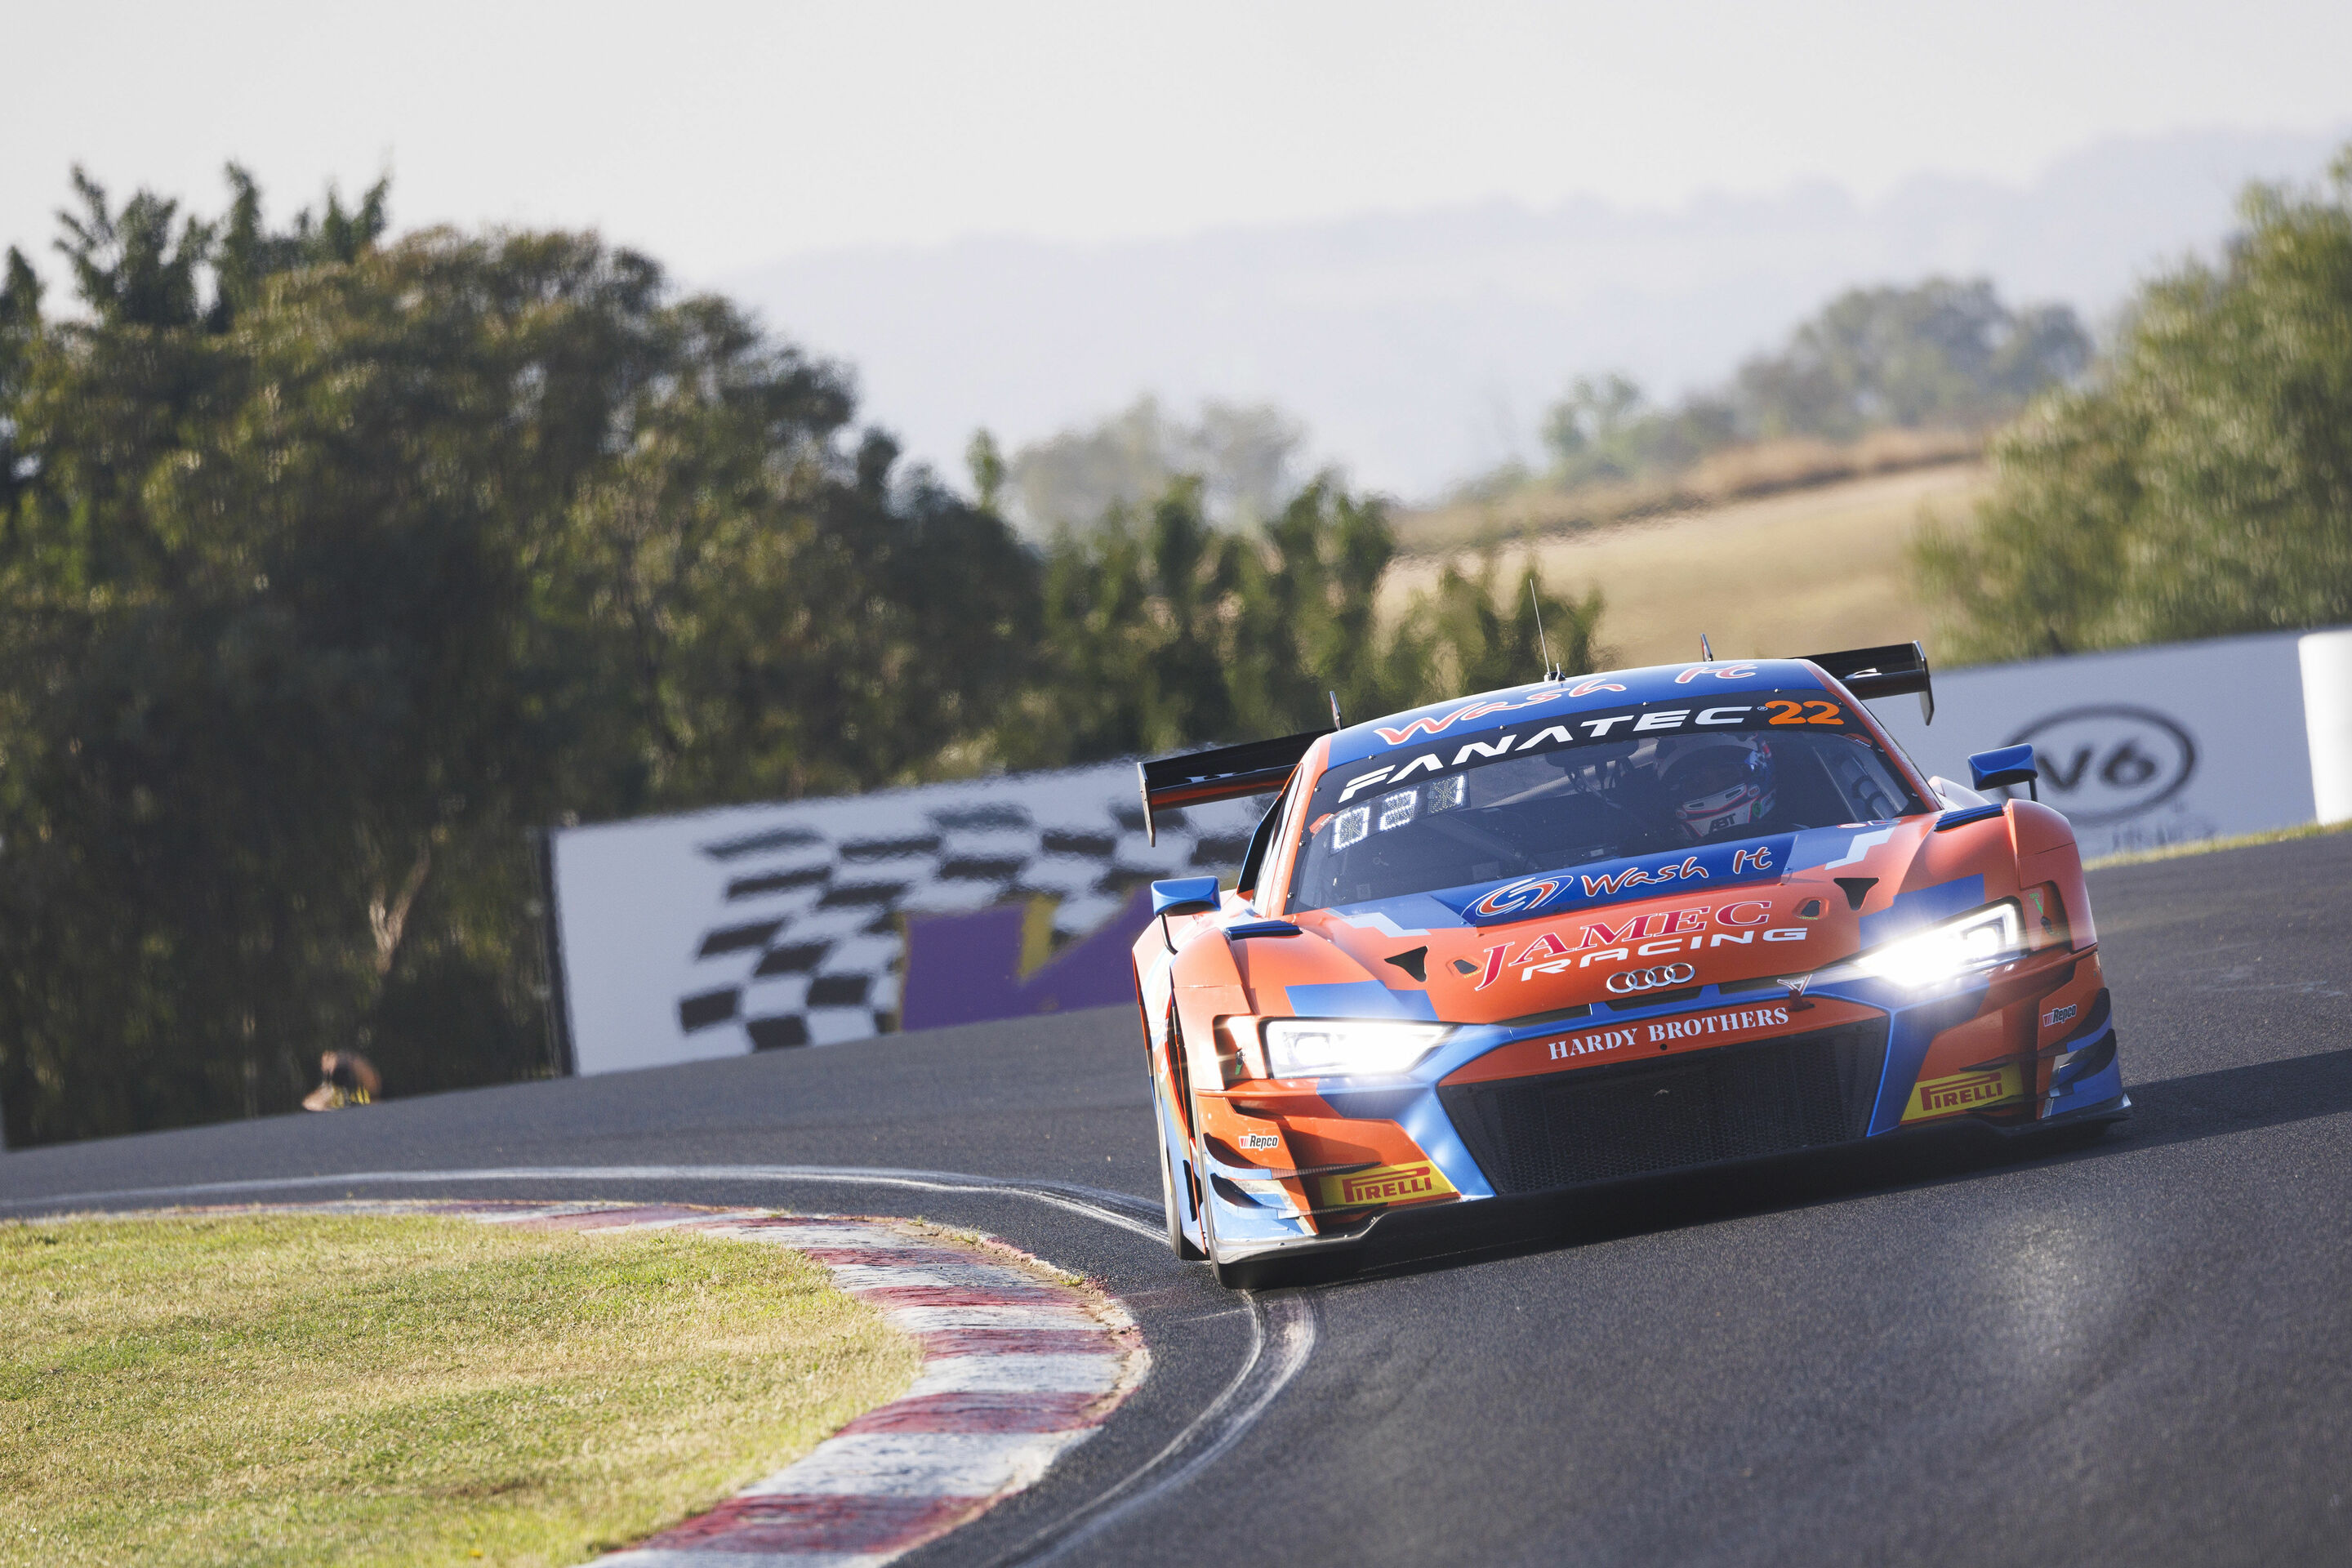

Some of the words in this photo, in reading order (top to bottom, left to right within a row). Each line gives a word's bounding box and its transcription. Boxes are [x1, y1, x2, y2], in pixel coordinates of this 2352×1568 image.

[1373, 678, 1628, 746] Wash
[1675, 663, 1758, 684] It
[1765, 700, 1845, 726] 22
[1580, 857, 1710, 898] Wash
[1732, 846, 1773, 874] It
[1474, 900, 1773, 991] JAMEC
[1521, 927, 1808, 982] RACING
[1548, 1027, 1638, 1060] HARDY
[1647, 1006, 1790, 1043] BROTHERS
[2052, 1004, 2077, 1023] Repco
[1919, 1071, 2004, 1111] PIRELLI
[1250, 1134, 1278, 1150] Repco
[1342, 1166, 1433, 1203] PIRELLI
